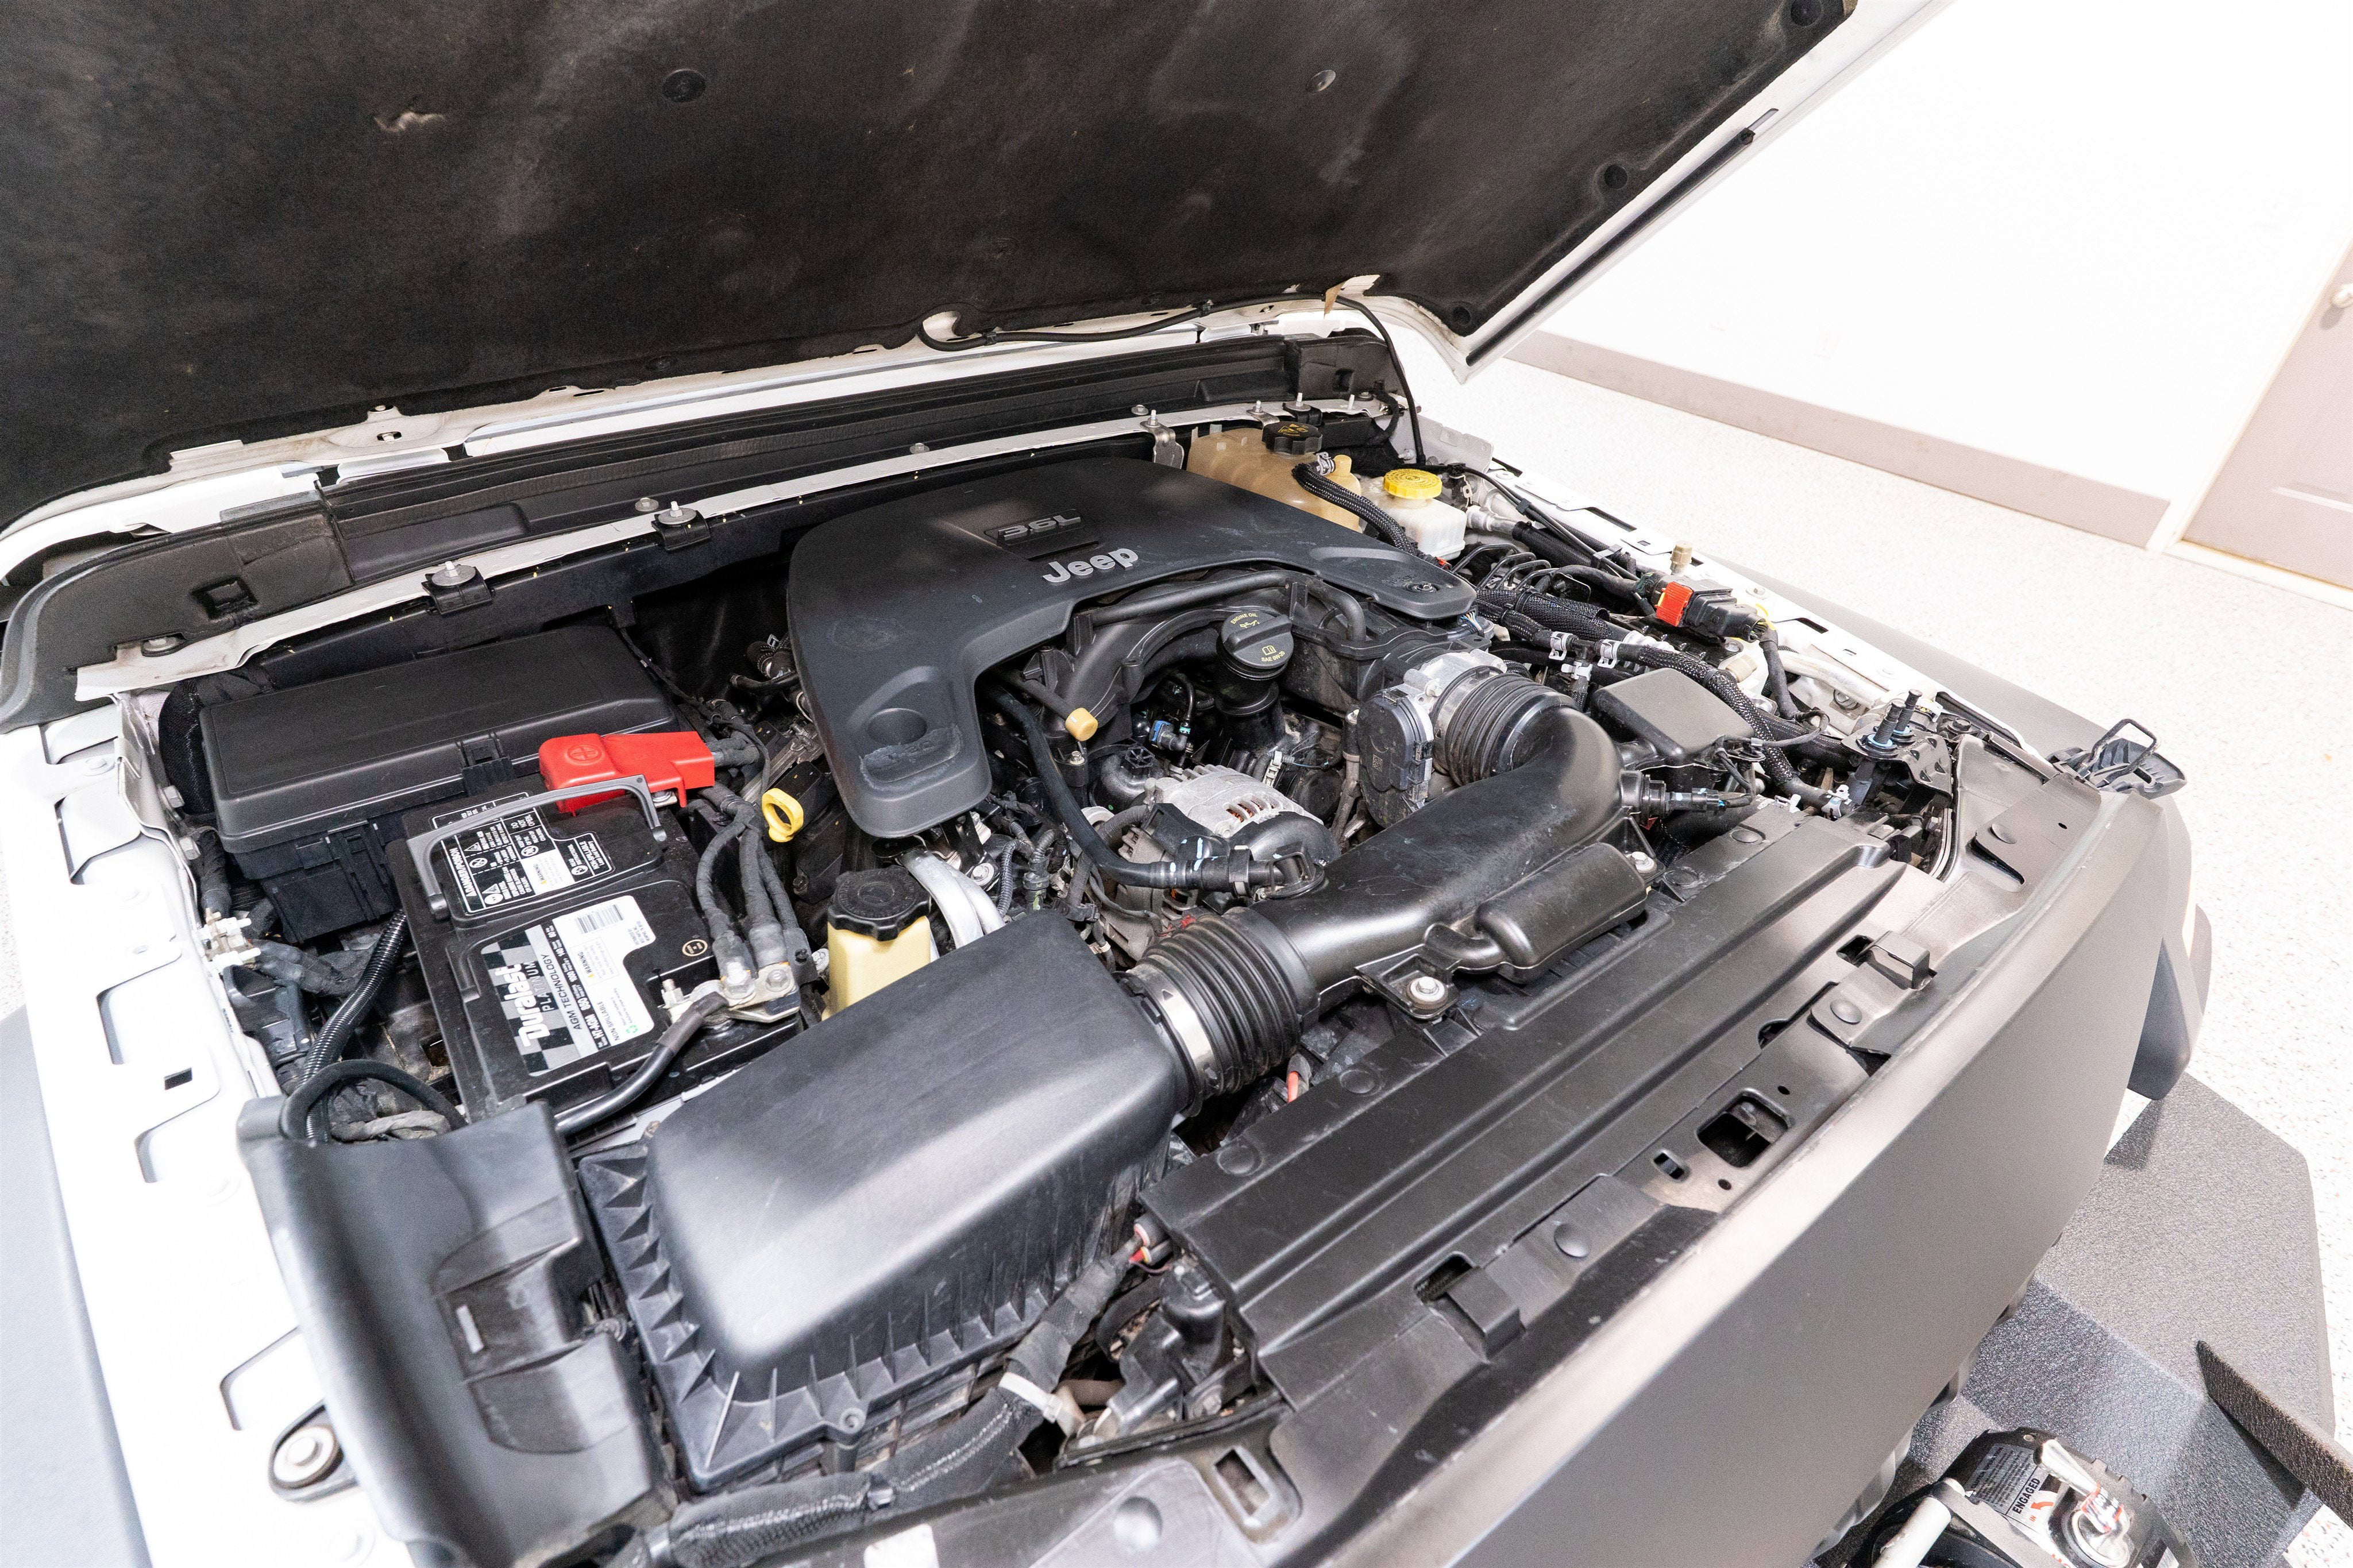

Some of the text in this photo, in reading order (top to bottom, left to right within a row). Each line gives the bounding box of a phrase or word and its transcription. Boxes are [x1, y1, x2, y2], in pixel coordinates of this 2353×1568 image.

[1042, 548, 1139, 584] Jeep
[1230, 613, 1248, 624] ENGINE
[518, 819, 527, 828] NOT
[523, 960, 555, 1013] PLATINUM
[541, 954, 572, 1009] TECHNOLOGY
[494, 964, 550, 1047] Duralast
[567, 1010, 583, 1030] AGM
[577, 997, 591, 1011] 850
[2012, 1478, 2040, 1514] ENGAGED
